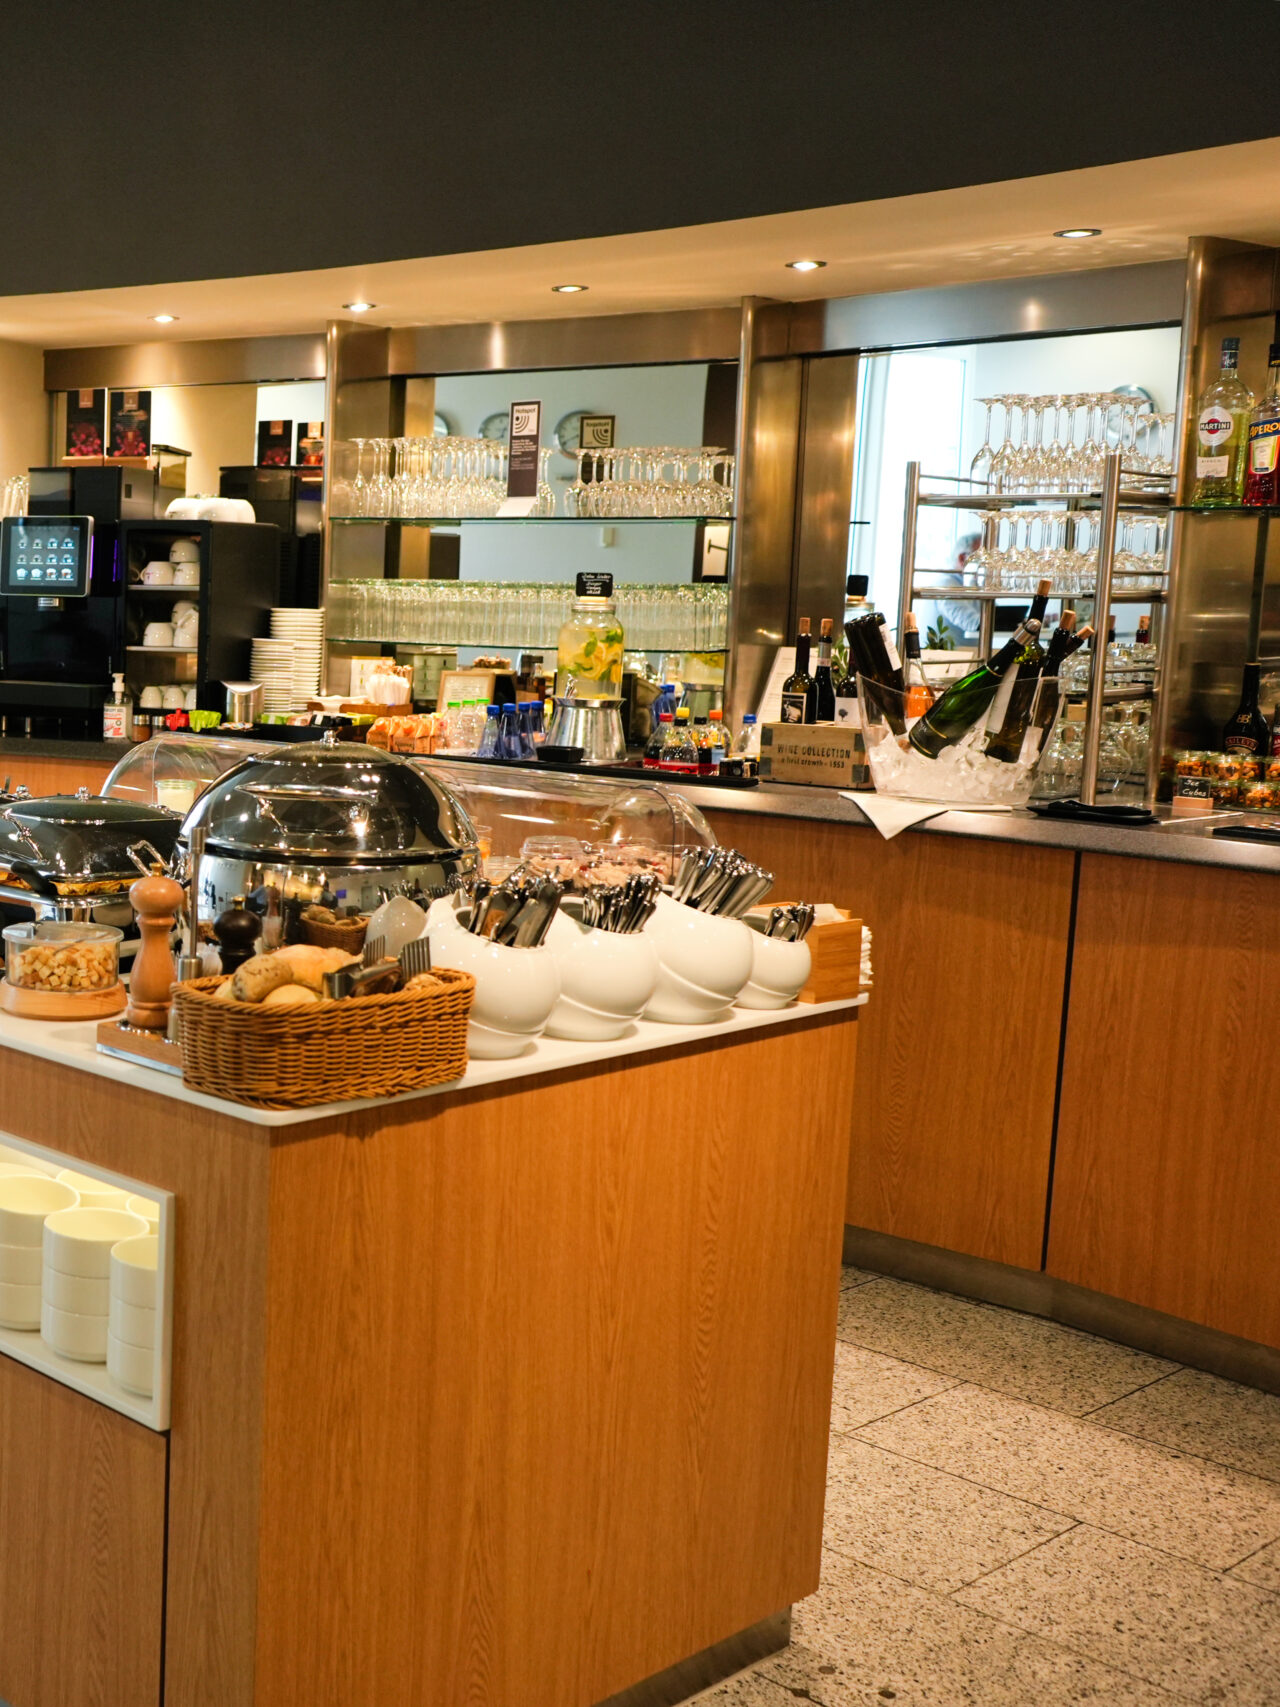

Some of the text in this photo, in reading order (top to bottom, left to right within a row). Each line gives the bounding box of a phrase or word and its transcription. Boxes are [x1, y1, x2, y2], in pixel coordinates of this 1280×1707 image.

[1200, 422, 1230, 430] MARTINI
[777, 744, 851, 759] WINE COLLECTION
[800, 757, 824, 767] growth
[1182, 788, 1207, 797] Cubes
